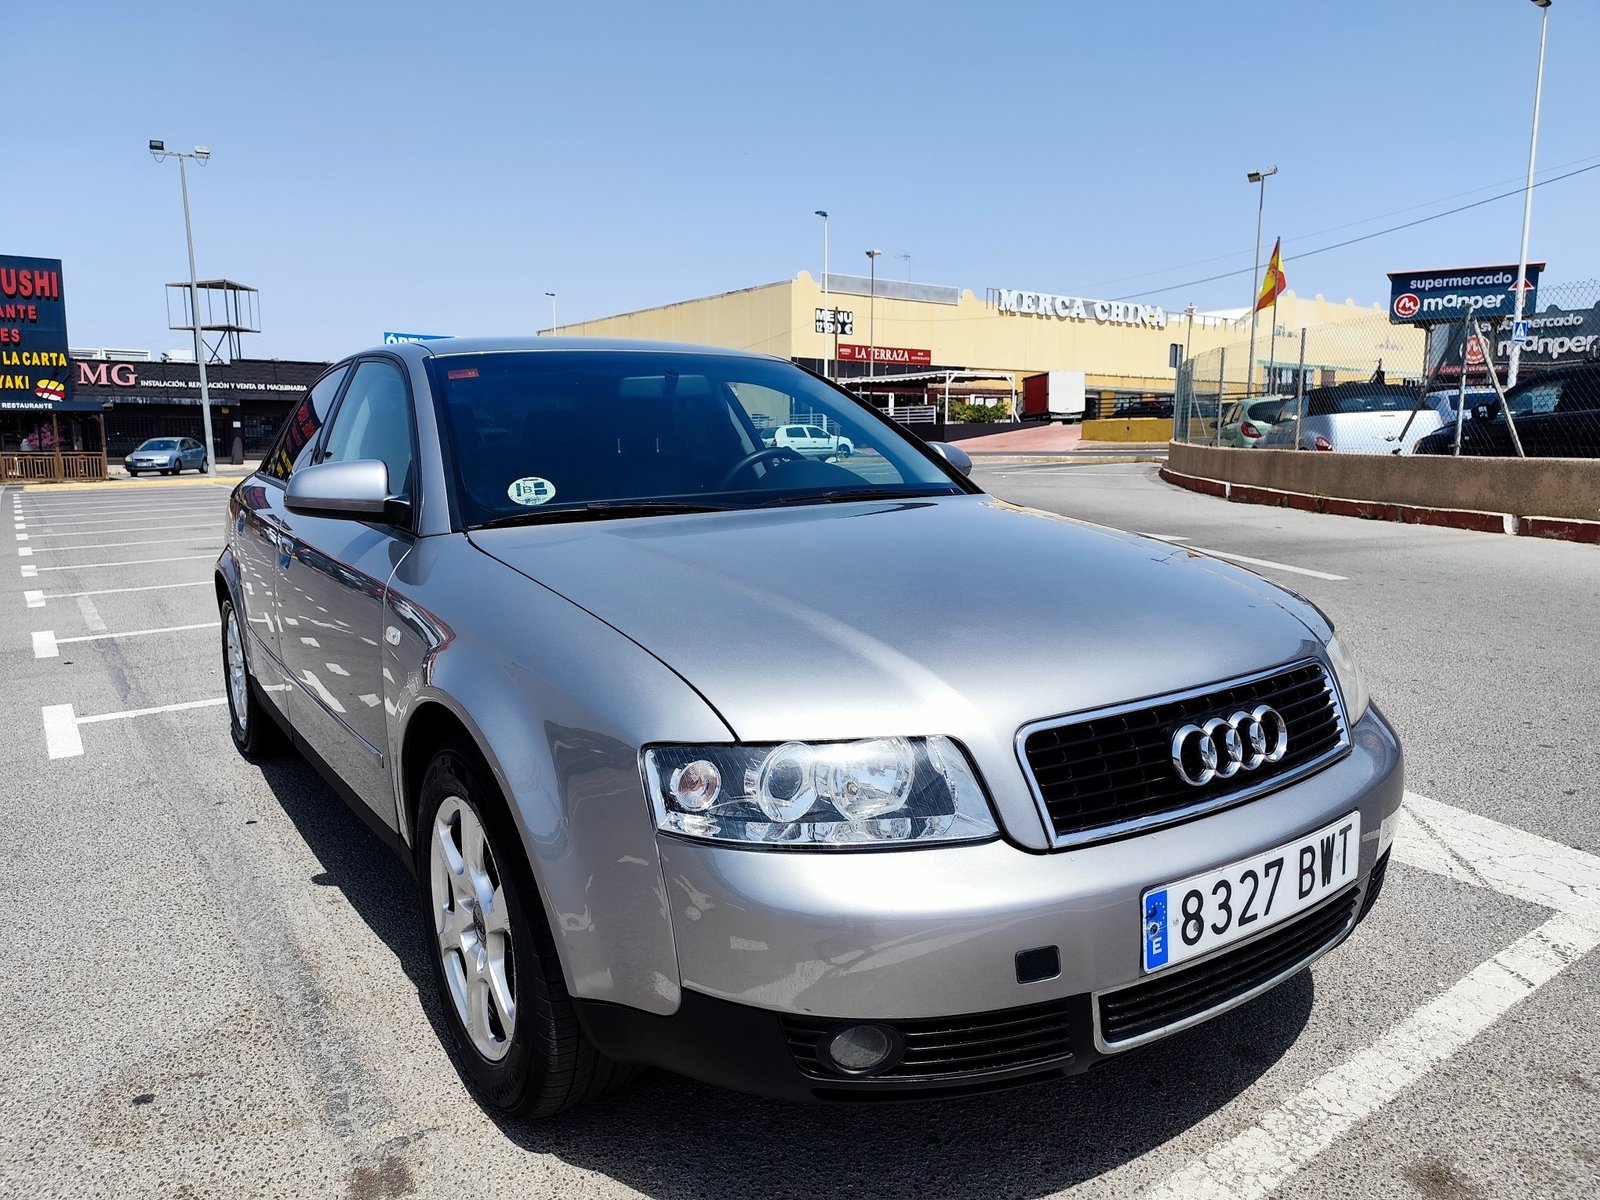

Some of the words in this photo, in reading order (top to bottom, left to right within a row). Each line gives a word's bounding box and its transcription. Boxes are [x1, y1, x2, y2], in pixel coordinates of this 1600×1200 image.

[1, 268, 58, 298] USHI
[1410, 272, 1512, 290] supermercado
[998, 289, 1088, 319] MERCA
[1094, 301, 1167, 327] CHINA
[1423, 294, 1505, 312] manper
[816, 309, 852, 323] MENU
[0, 328, 20, 342] ES
[3, 351, 20, 365] LA
[22, 352, 67, 367] CARTA
[855, 347, 867, 359] LA
[77, 362, 138, 386] MG
[188, 381, 229, 389] REPACIÓN
[1181, 857, 1284, 946] 8327
[1298, 823, 1353, 900] BWT
[1151, 936, 1162, 955] E
